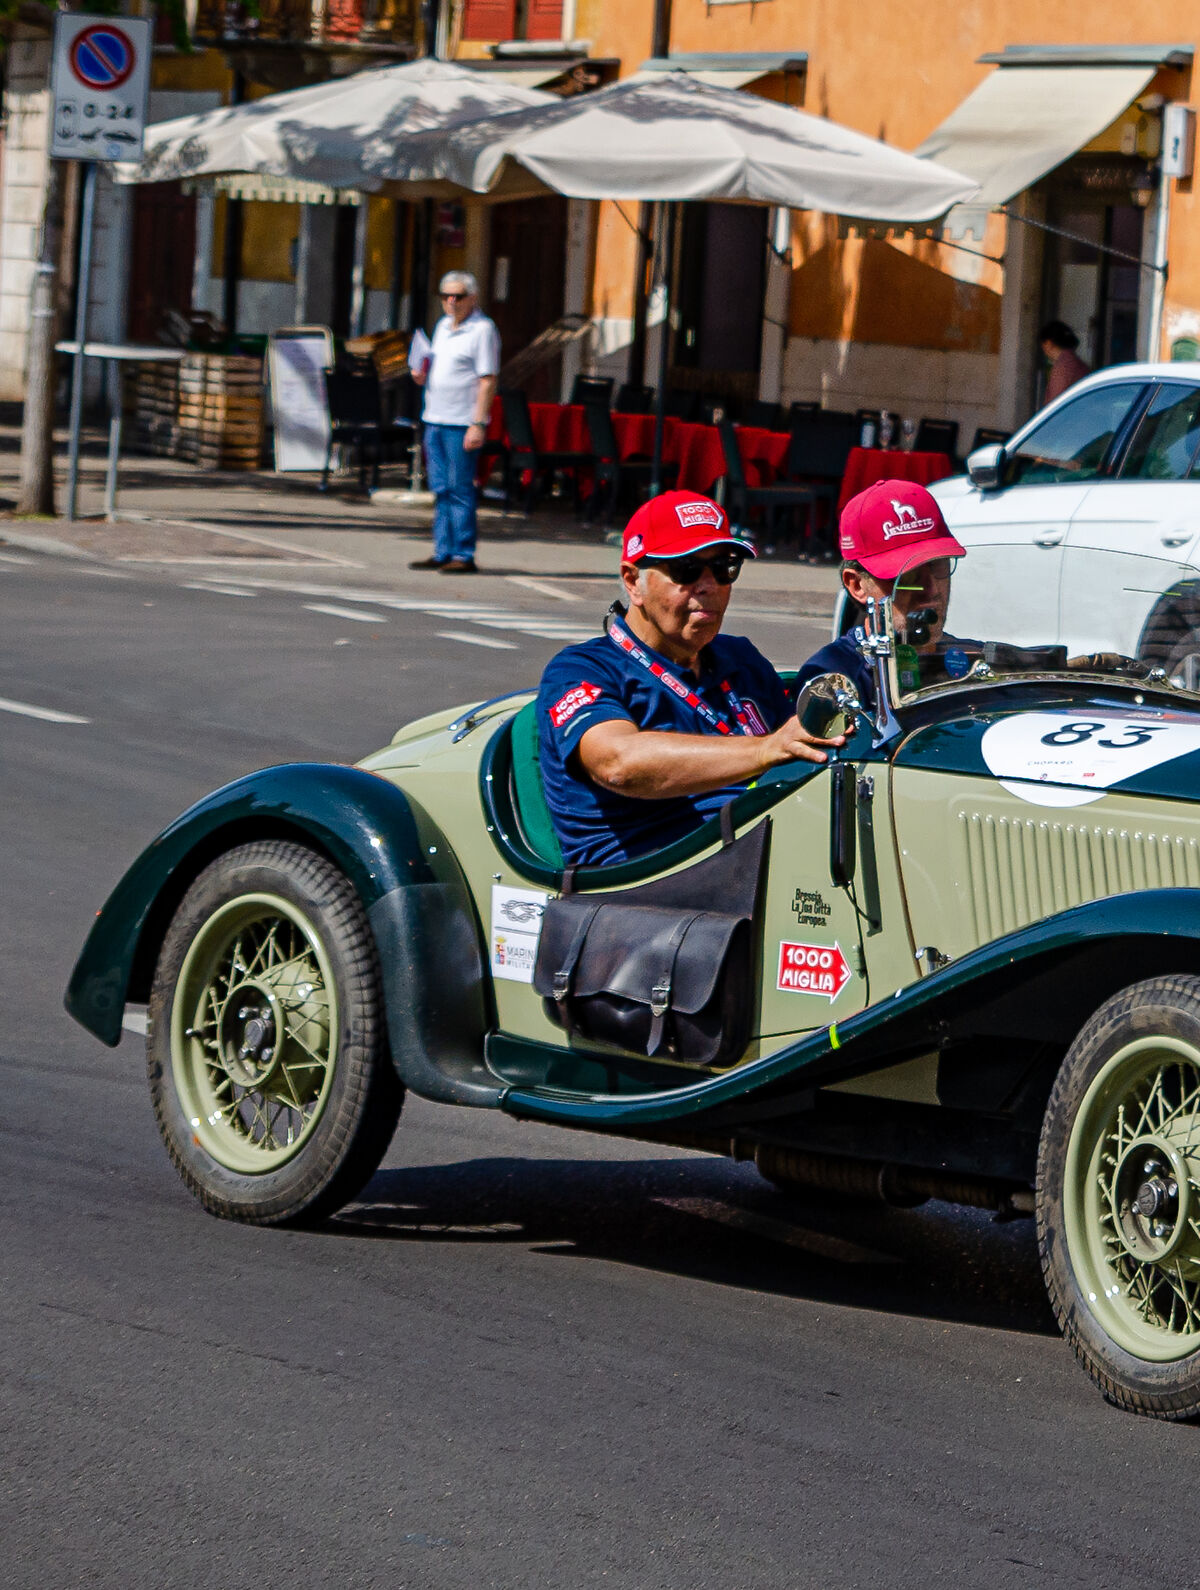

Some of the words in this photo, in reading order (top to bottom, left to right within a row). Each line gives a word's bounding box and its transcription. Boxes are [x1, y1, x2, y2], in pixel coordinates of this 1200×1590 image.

[556, 689, 586, 713] 1000
[556, 696, 592, 724] MIGLIA
[1041, 722, 1169, 749] 83
[506, 946, 534, 960] MARIN
[787, 947, 833, 969] 1000
[782, 969, 835, 991] MIGLIA
